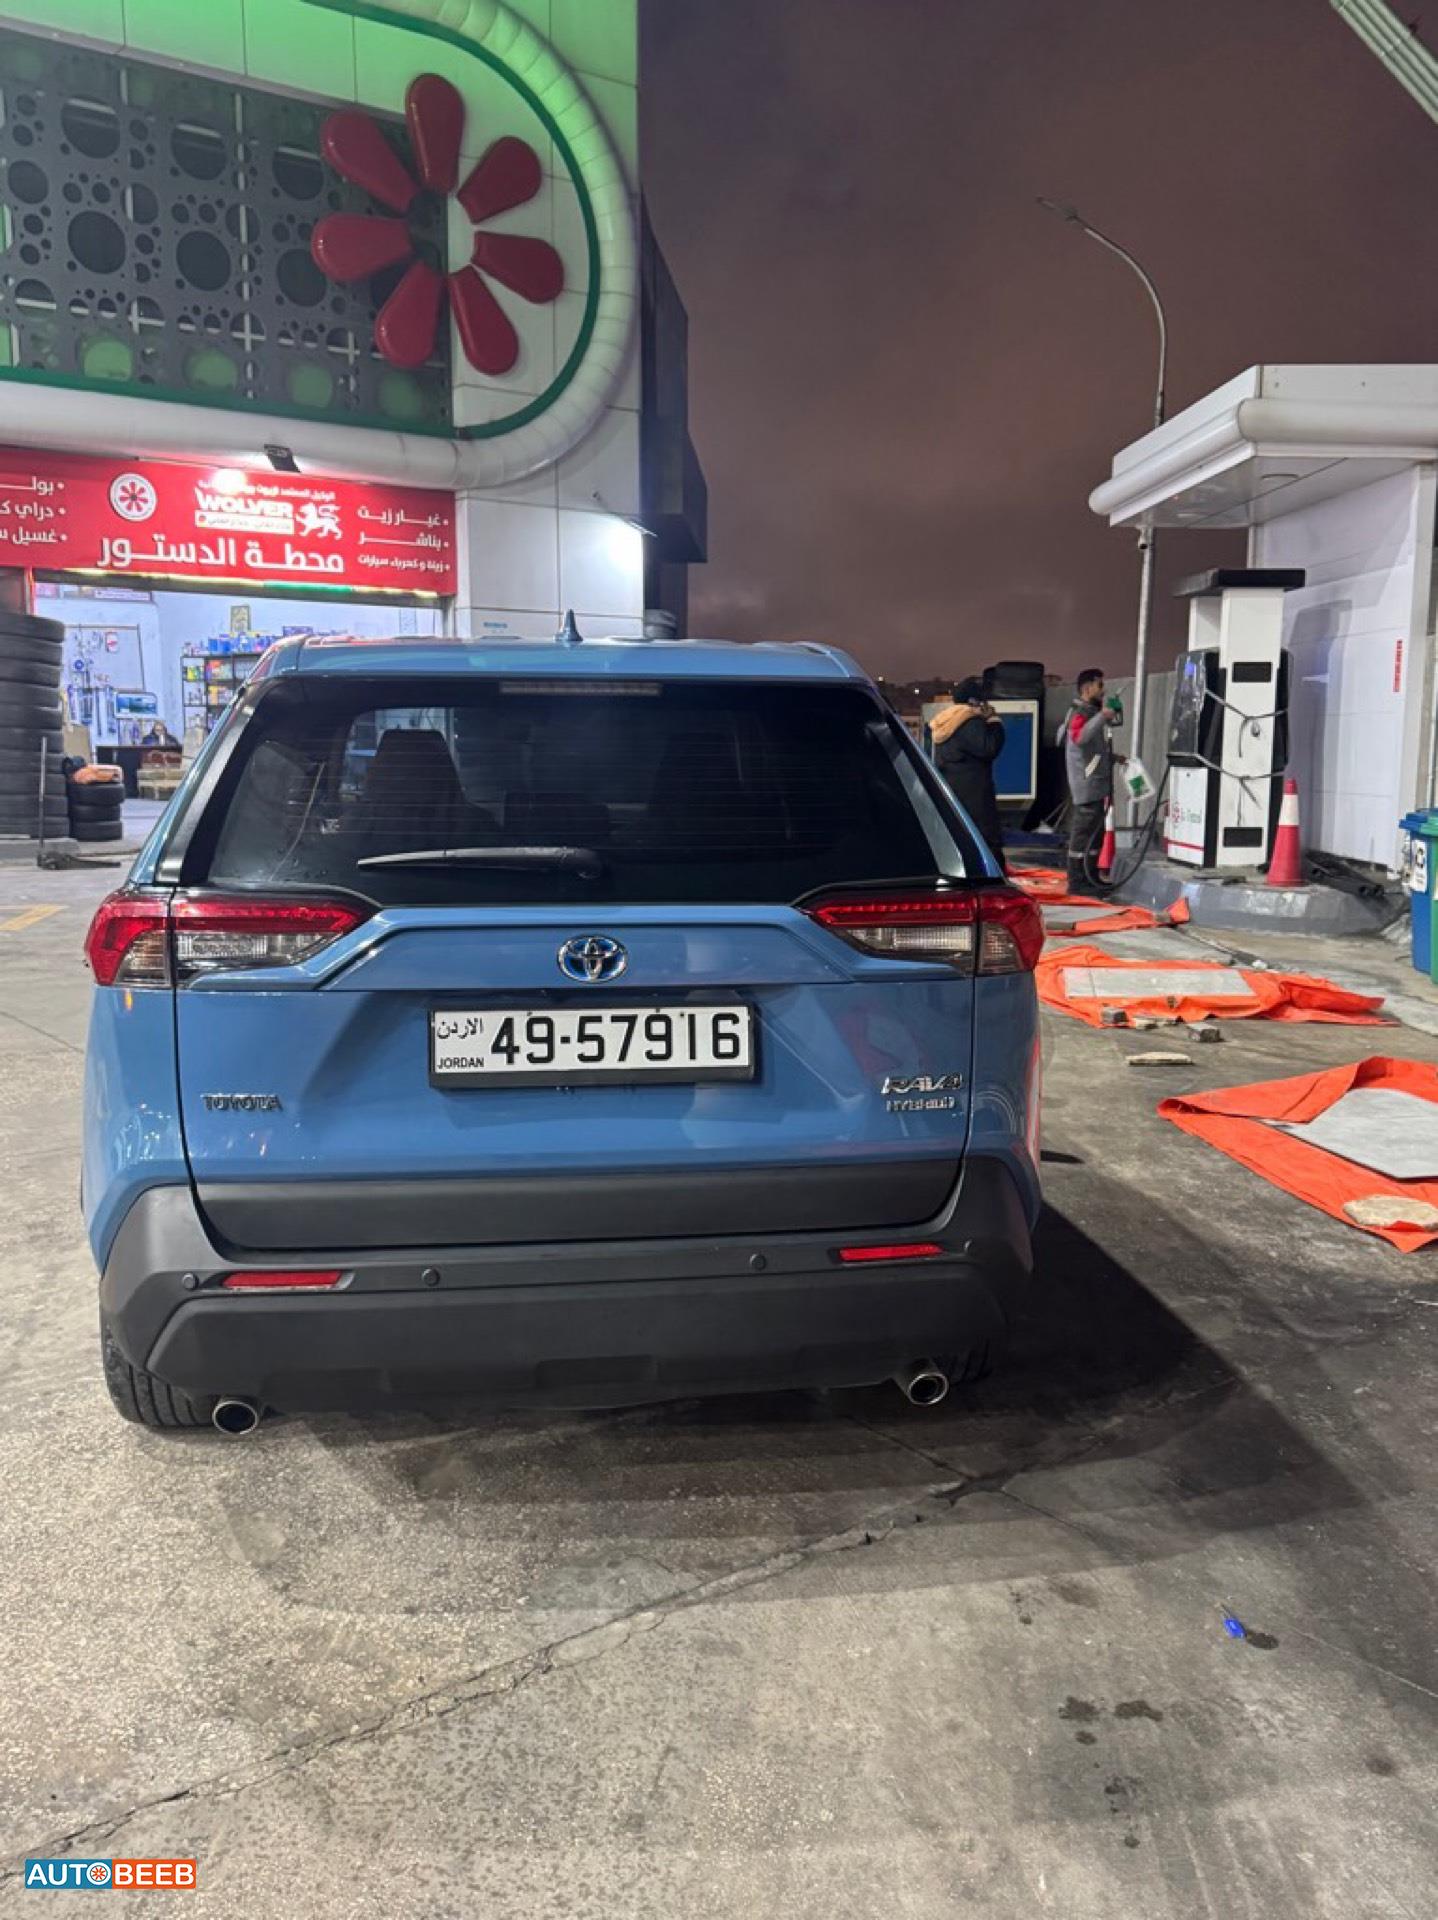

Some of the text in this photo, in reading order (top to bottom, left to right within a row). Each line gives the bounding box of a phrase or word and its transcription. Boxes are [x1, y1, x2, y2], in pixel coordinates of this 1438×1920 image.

[195, 487, 294, 518] WOLVER
[12, 526, 58, 546] غسيل
[96, 533, 345, 574] محطة الدستور
[490, 1013, 740, 1065] 49-57916
[436, 1057, 485, 1069] JORDAN
